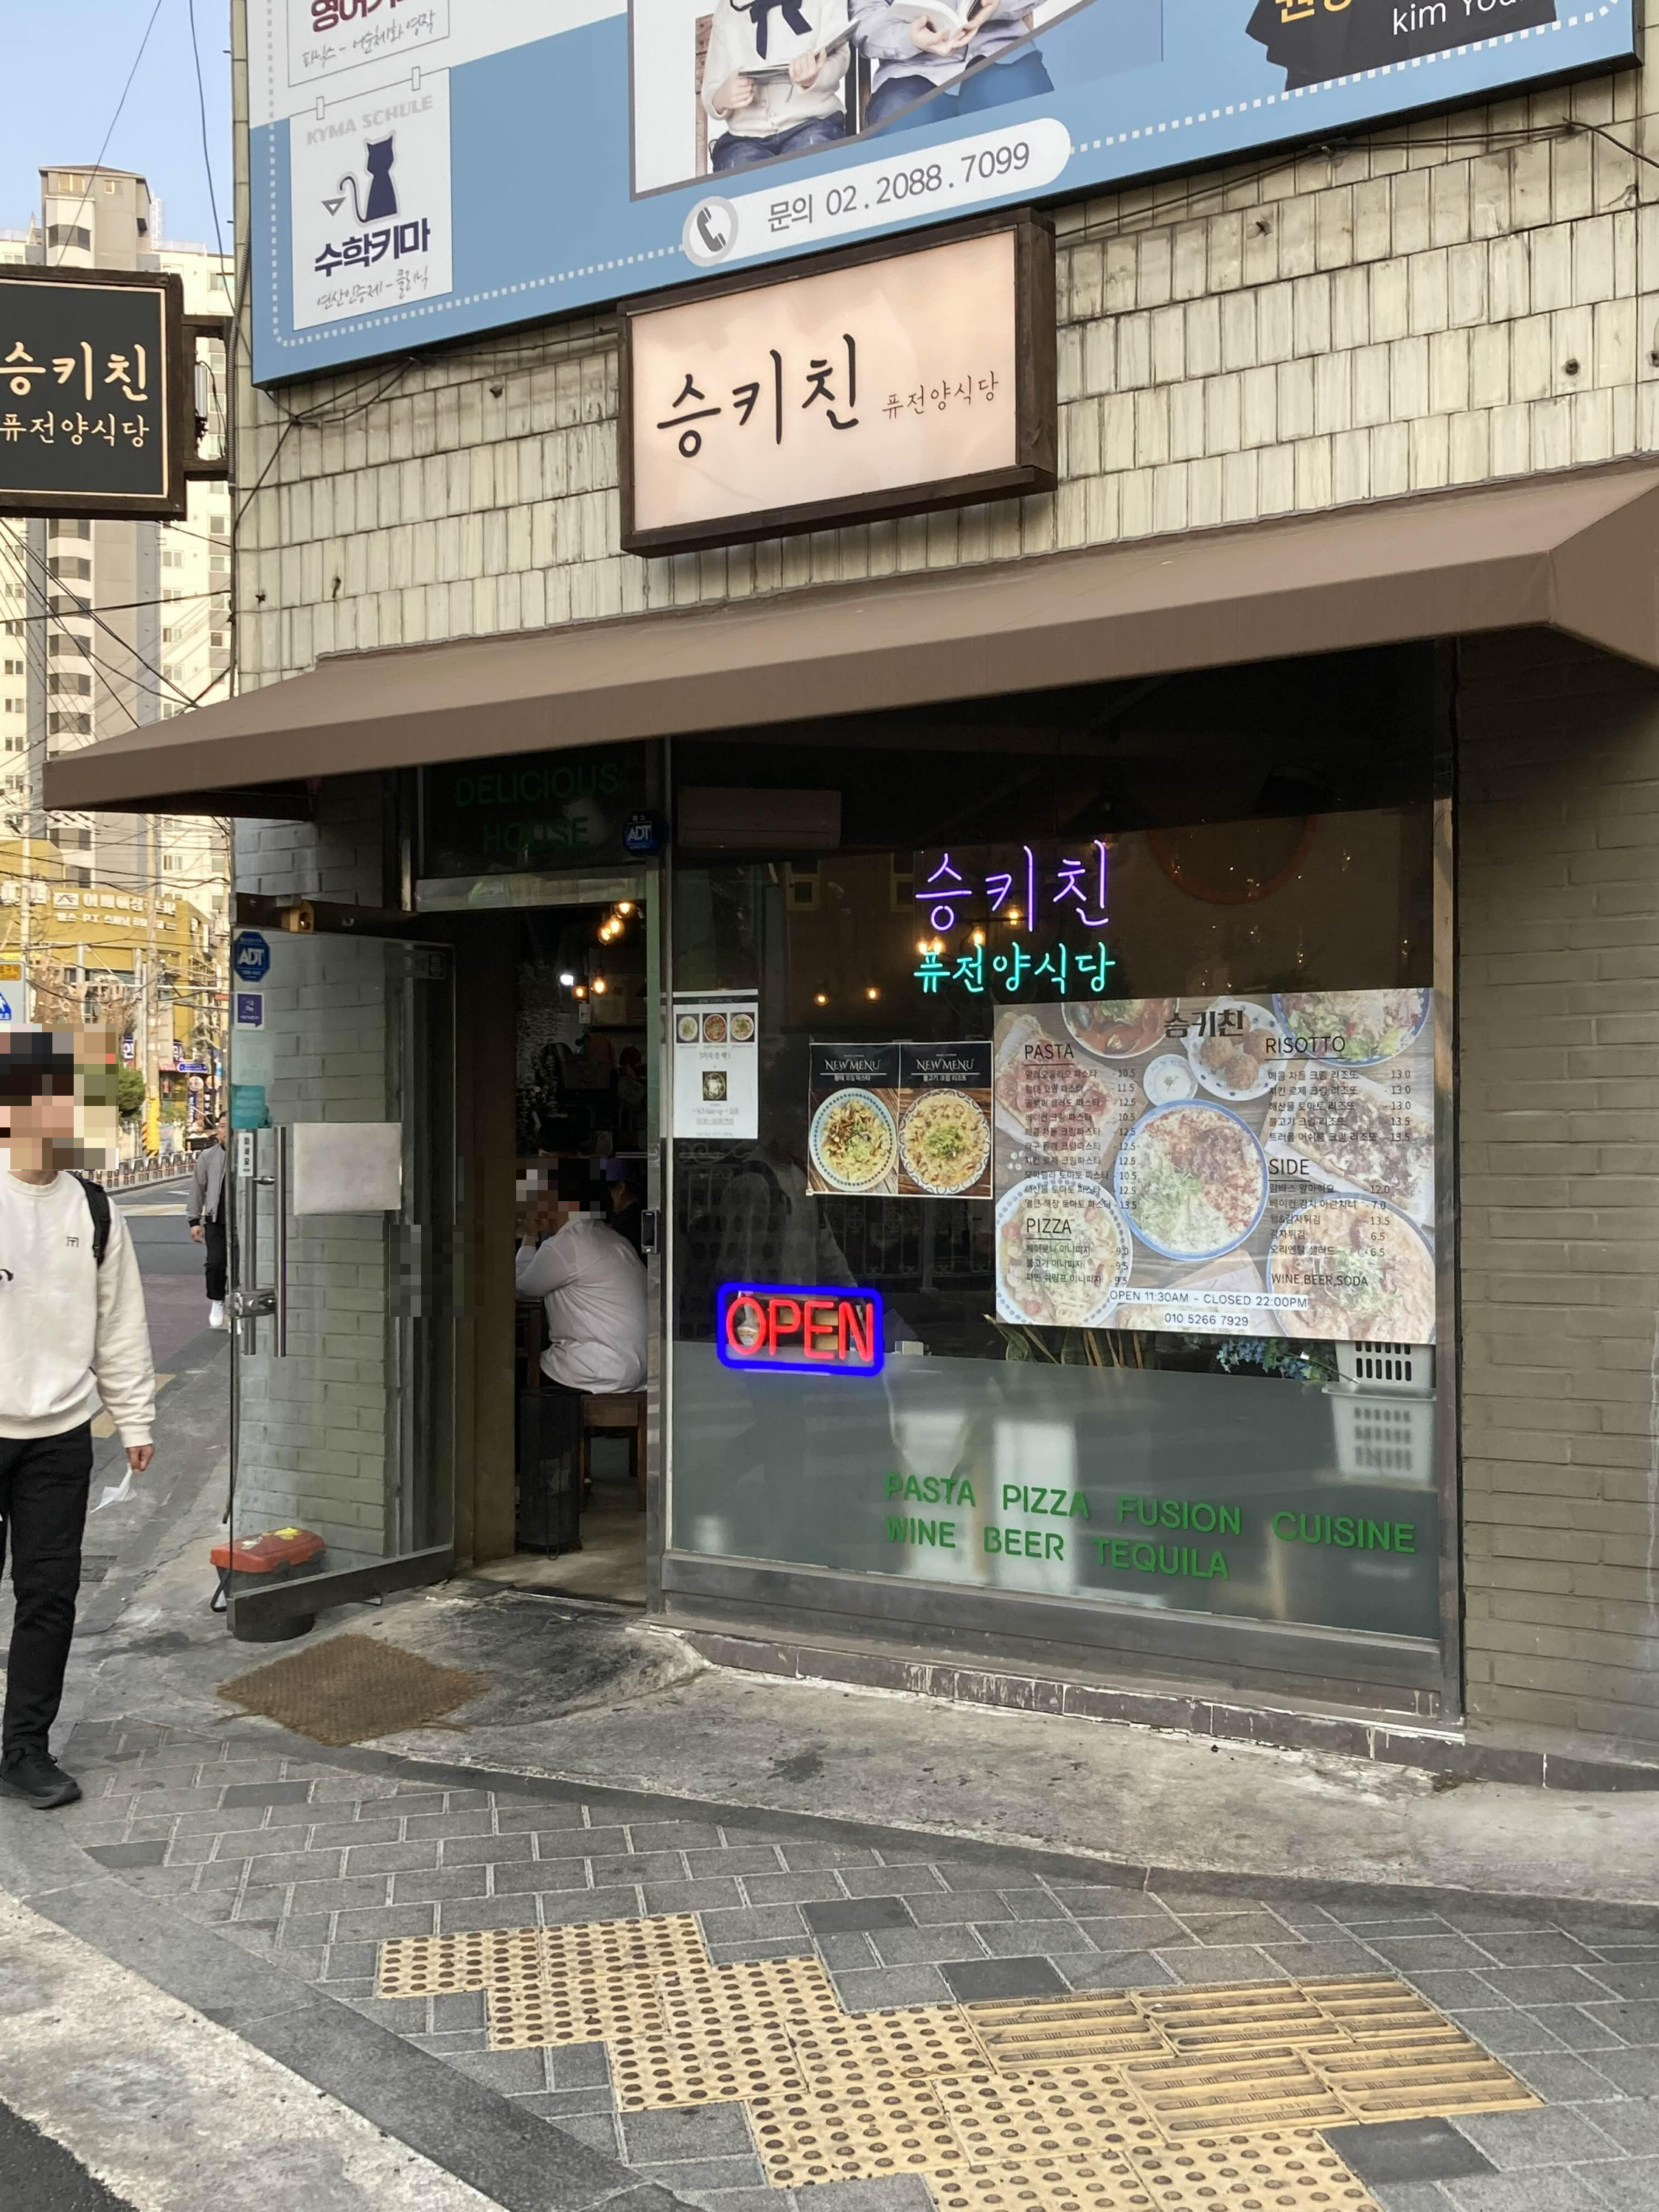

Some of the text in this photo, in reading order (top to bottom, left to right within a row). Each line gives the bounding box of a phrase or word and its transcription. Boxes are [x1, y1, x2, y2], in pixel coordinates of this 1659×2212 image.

[1393, 2, 1447, 35] kim
[307, 95, 434, 145] KYMA SCHULE
[768, 194, 813, 232] 문의
[314, 217, 431, 277] 수학키마
[0, 341, 148, 401] 승키친
[657, 333, 999, 458] 승키친 퓨전양식당
[0, 411, 150, 448] 퓨전양식당
[456, 763, 619, 807] DELICIOUS
[483, 816, 589, 853] HOUSE
[627, 824, 652, 841] ADT
[916, 839, 1109, 933] 승키친
[237, 947, 265, 966] ADT
[914, 942, 1116, 994] 퓨전양식당
[1164, 1009, 1244, 1038] 승키친
[1023, 1043, 1074, 1060] PASTA
[1265, 1036, 1346, 1054] RISOTTO
[824, 1058, 881, 1071] NEW MENU
[916, 1058, 975, 1071] NEW MENU
[1074, 1069, 1097, 1078] 파스타
[1118, 1069, 1135, 1077] 10.5
[1310, 1071, 1326, 1080] 크림
[1331, 1071, 1359, 1079] 리조또
[1391, 1070, 1411, 1079] 13.0
[1060, 1085, 1084, 1093] 파스타
[1117, 1084, 1135, 1092] 11.5
[1269, 1085, 1411, 1096] 치킨 로제 크림 리조또 13.0
[1077, 1099, 1100, 1107] 파스타
[1119, 1099, 1136, 1107] 12.5
[1268, 1102, 1411, 1111] 해산물 토마토 리조또 13.0
[1069, 1113, 1093, 1121] 파스타
[1119, 1113, 1135, 1121] 10.5
[1269, 1117, 1411, 1127] 불고기 크림 리조또 13.5
[1119, 1128, 1136, 1136] 12.5
[1269, 1133, 1295, 1142] 트러플
[1329, 1133, 1346, 1142] 크림
[1349, 1133, 1377, 1141] 리조또
[1390, 1133, 1411, 1141] 13.5
[1119, 1142, 1136, 1151] 12.5
[1119, 1157, 1136, 1165] 12.5
[1269, 1159, 1310, 1175] SIDE
[1059, 1171, 1082, 1180] 토마토
[1085, 1171, 1108, 1180] 파스타
[1119, 1172, 1137, 1180] 10.5
[1051, 1185, 1074, 1194] 토마토
[1077, 1185, 1101, 1194] 파스타
[1119, 1186, 1136, 1194] 12.5
[1270, 1184, 1295, 1193] 감바스
[1370, 1185, 1391, 1194] 12.0
[1062, 1200, 1085, 1208] 토마토
[1088, 1200, 1111, 1208] 파스타
[1120, 1200, 1137, 1209] 13.5
[1270, 1200, 1296, 1208] 베이컨
[1299, 1200, 1316, 1208] 김치
[1372, 1200, 1386, 1210] 7.0
[1026, 1218, 1072, 1234] PIZZA
[1370, 1217, 1390, 1225] 13.5
[1270, 1230, 1385, 1241] 감자튀김 6.5
[1059, 1245, 1091, 1253] 미니피자
[1116, 1247, 1129, 1256] 9.0
[1370, 1248, 1385, 1257] 6.5
[1051, 1259, 1084, 1268] 미니피자
[1116, 1262, 1128, 1270] 9.5
[1070, 1274, 1102, 1284] 미니피자
[1115, 1276, 1127, 1285] 9.5
[1110, 1290, 1141, 1301] OPEN
[1145, 1292, 1189, 1303] 11:30AM
[1203, 1294, 1251, 1306] CLOSED
[1256, 1296, 1307, 1308] 22:00PM
[1164, 1312, 1249, 1326] 010 5266 7929
[726, 1295, 874, 1362] OPEN
[885, 1471, 1416, 1553] PASTA PIZZA FUSION CUISINE
[885, 1516, 1230, 1581] WINE BEER TEQUILA
